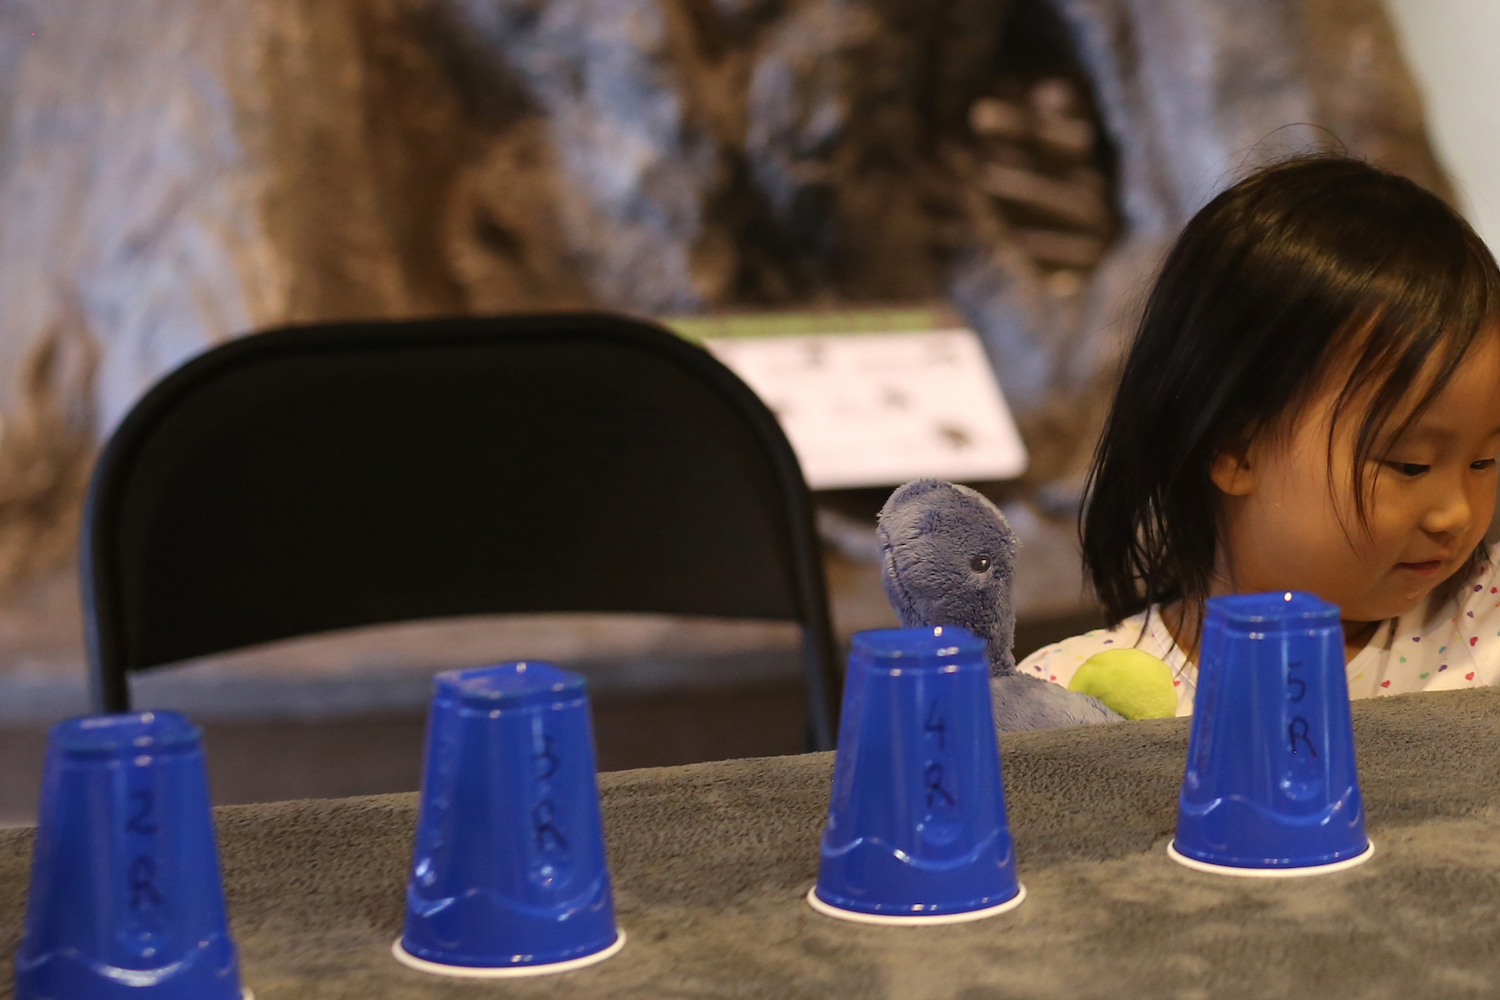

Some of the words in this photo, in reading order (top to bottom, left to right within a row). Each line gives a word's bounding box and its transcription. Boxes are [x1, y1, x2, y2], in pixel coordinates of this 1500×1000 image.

[1287, 661, 1306, 702] 5
[923, 699, 946, 750] 4
[1288, 716, 1318, 758] R
[923, 763, 957, 808] R
[125, 789, 159, 836] 2
[531, 799, 569, 850] R
[127, 855, 165, 911] R
